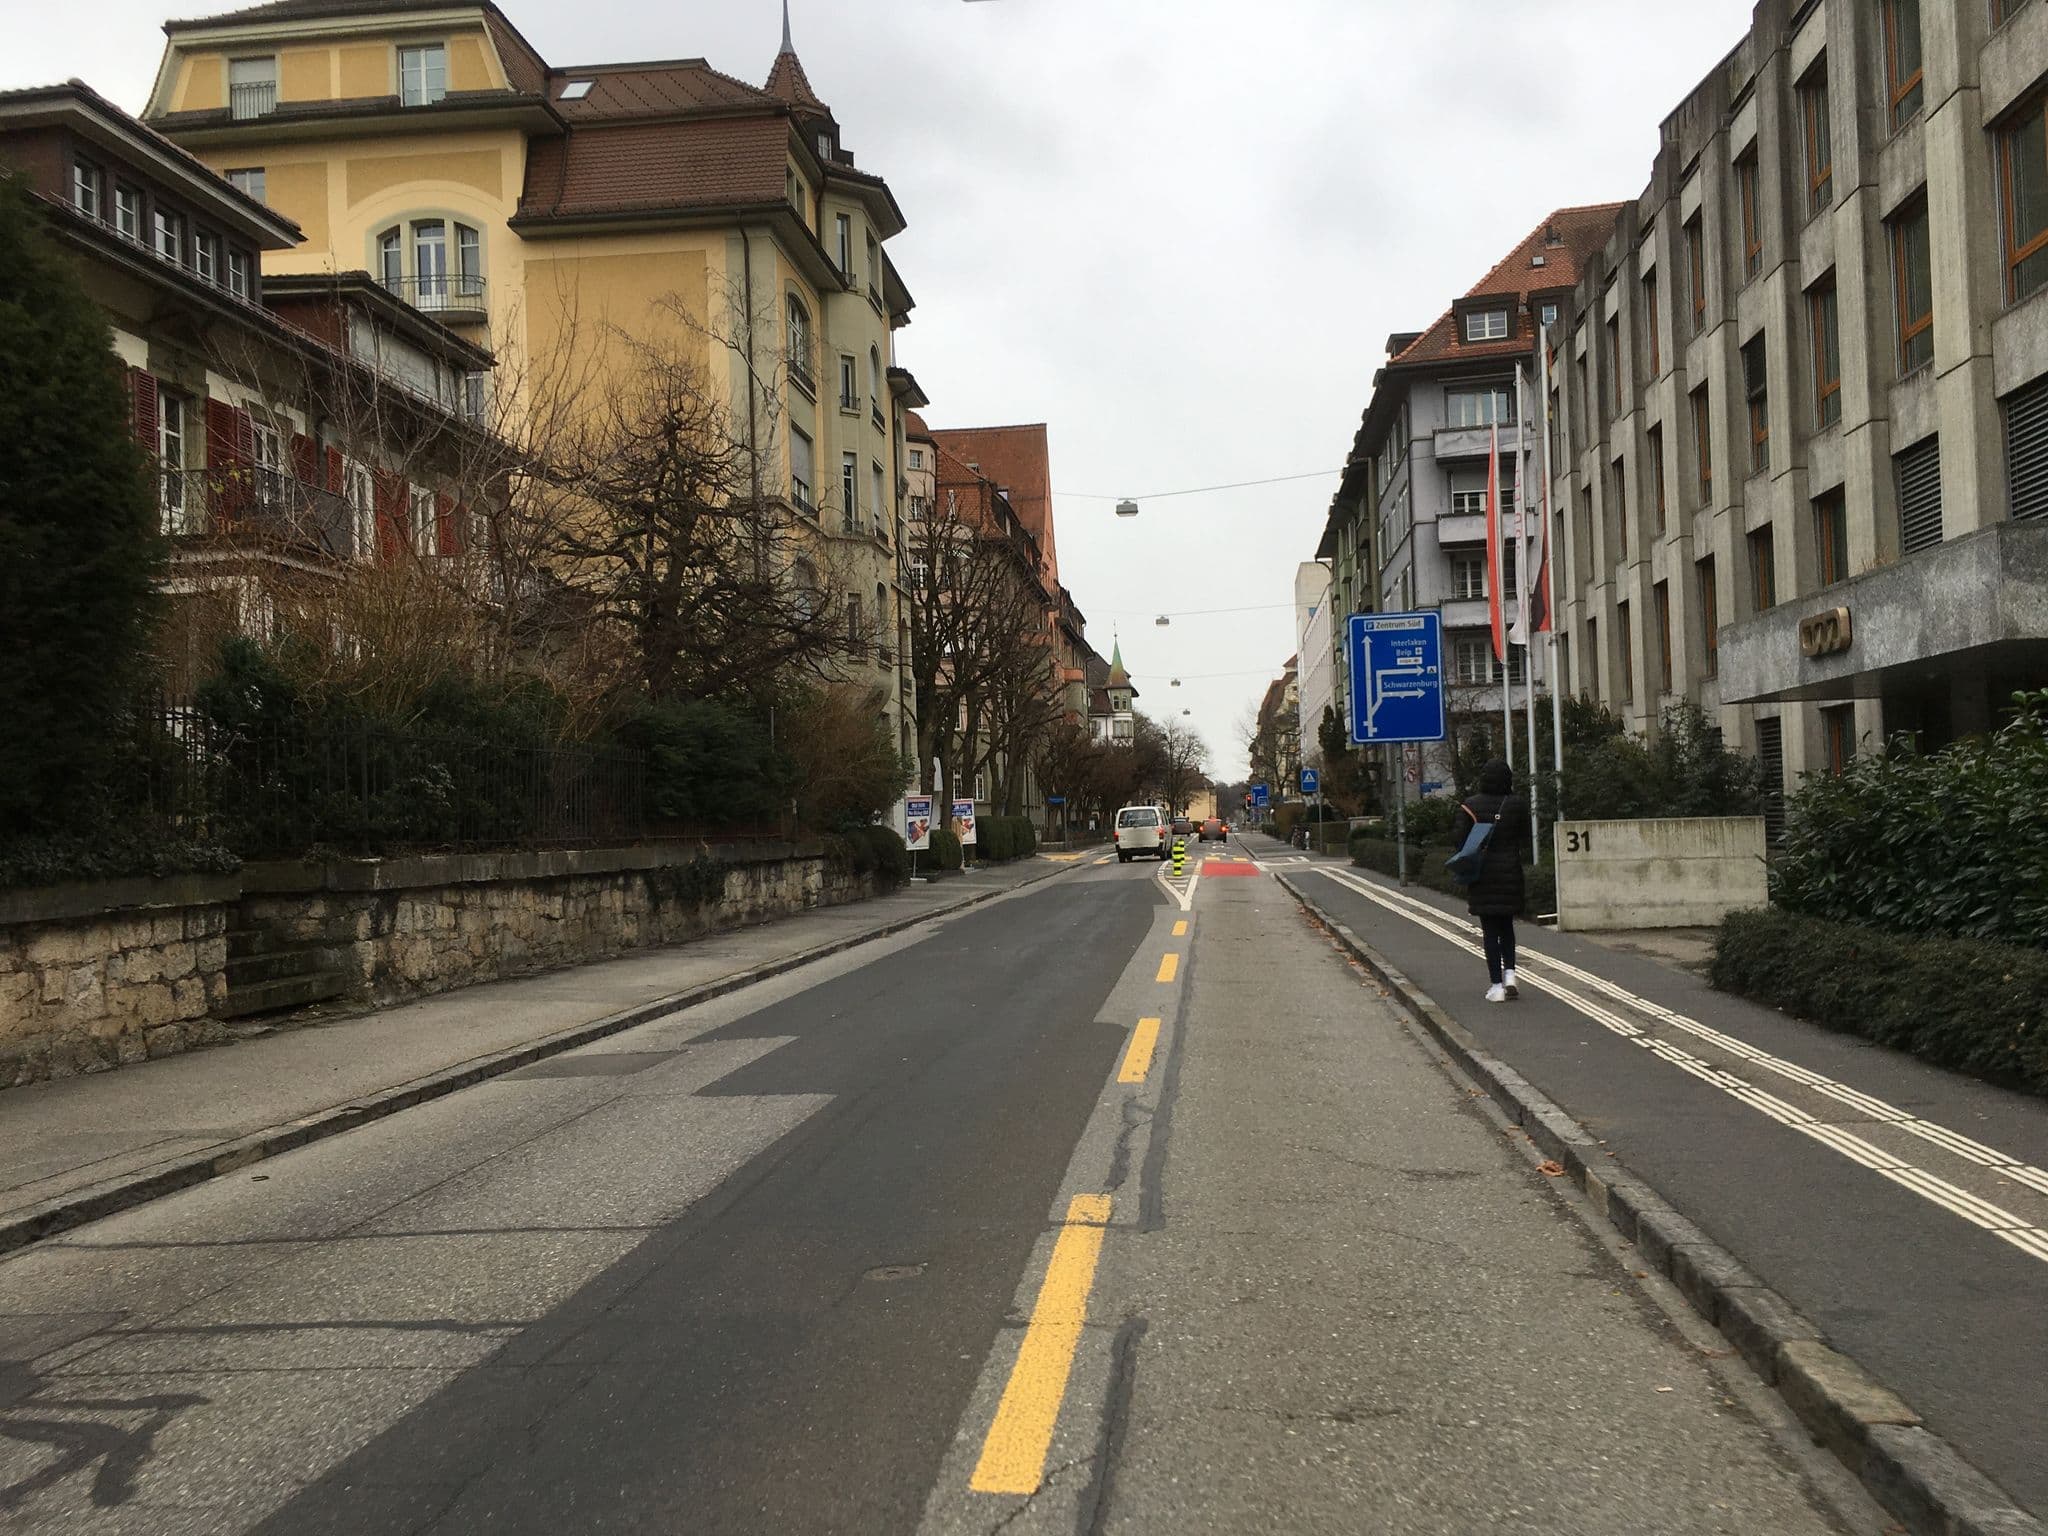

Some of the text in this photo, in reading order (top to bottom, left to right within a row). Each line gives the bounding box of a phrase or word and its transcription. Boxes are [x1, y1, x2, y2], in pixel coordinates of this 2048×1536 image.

[1376, 621, 1405, 629] Zentrum
[1391, 639, 1427, 647] Interlaken
[1384, 680, 1438, 689] Schwarzenburg
[1567, 831, 1590, 852] 31
